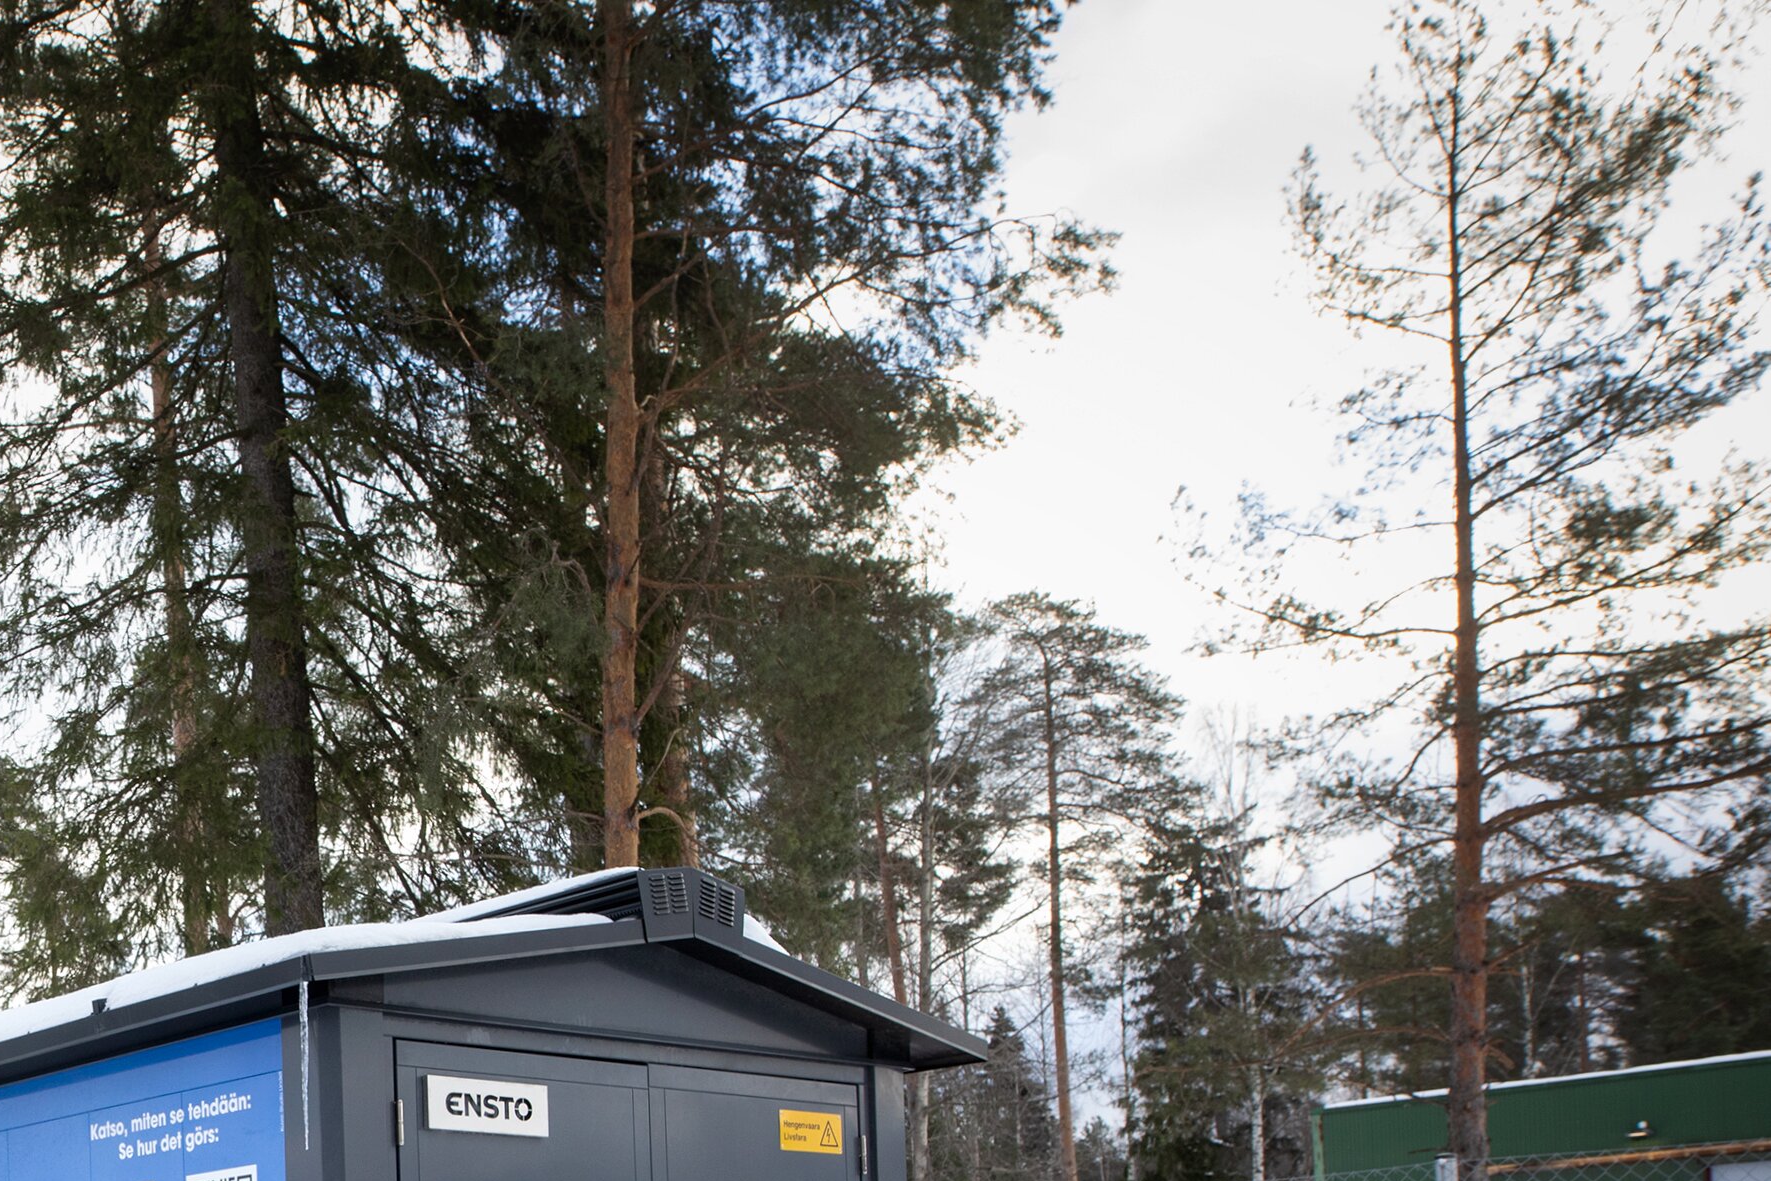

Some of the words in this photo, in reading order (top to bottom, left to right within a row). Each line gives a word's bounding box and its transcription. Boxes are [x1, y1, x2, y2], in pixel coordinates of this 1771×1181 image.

[90, 1121, 128, 1142] Katso,
[131, 1111, 167, 1133] miten
[170, 1108, 185, 1123] se
[187, 1092, 252, 1121] tehdään:
[445, 1092, 533, 1122] ENSTO
[783, 1120, 821, 1131] Hengenvaara
[118, 1142, 134, 1160] Se
[137, 1138, 158, 1159] hur
[160, 1134, 182, 1153] det
[185, 1127, 220, 1153] görs:
